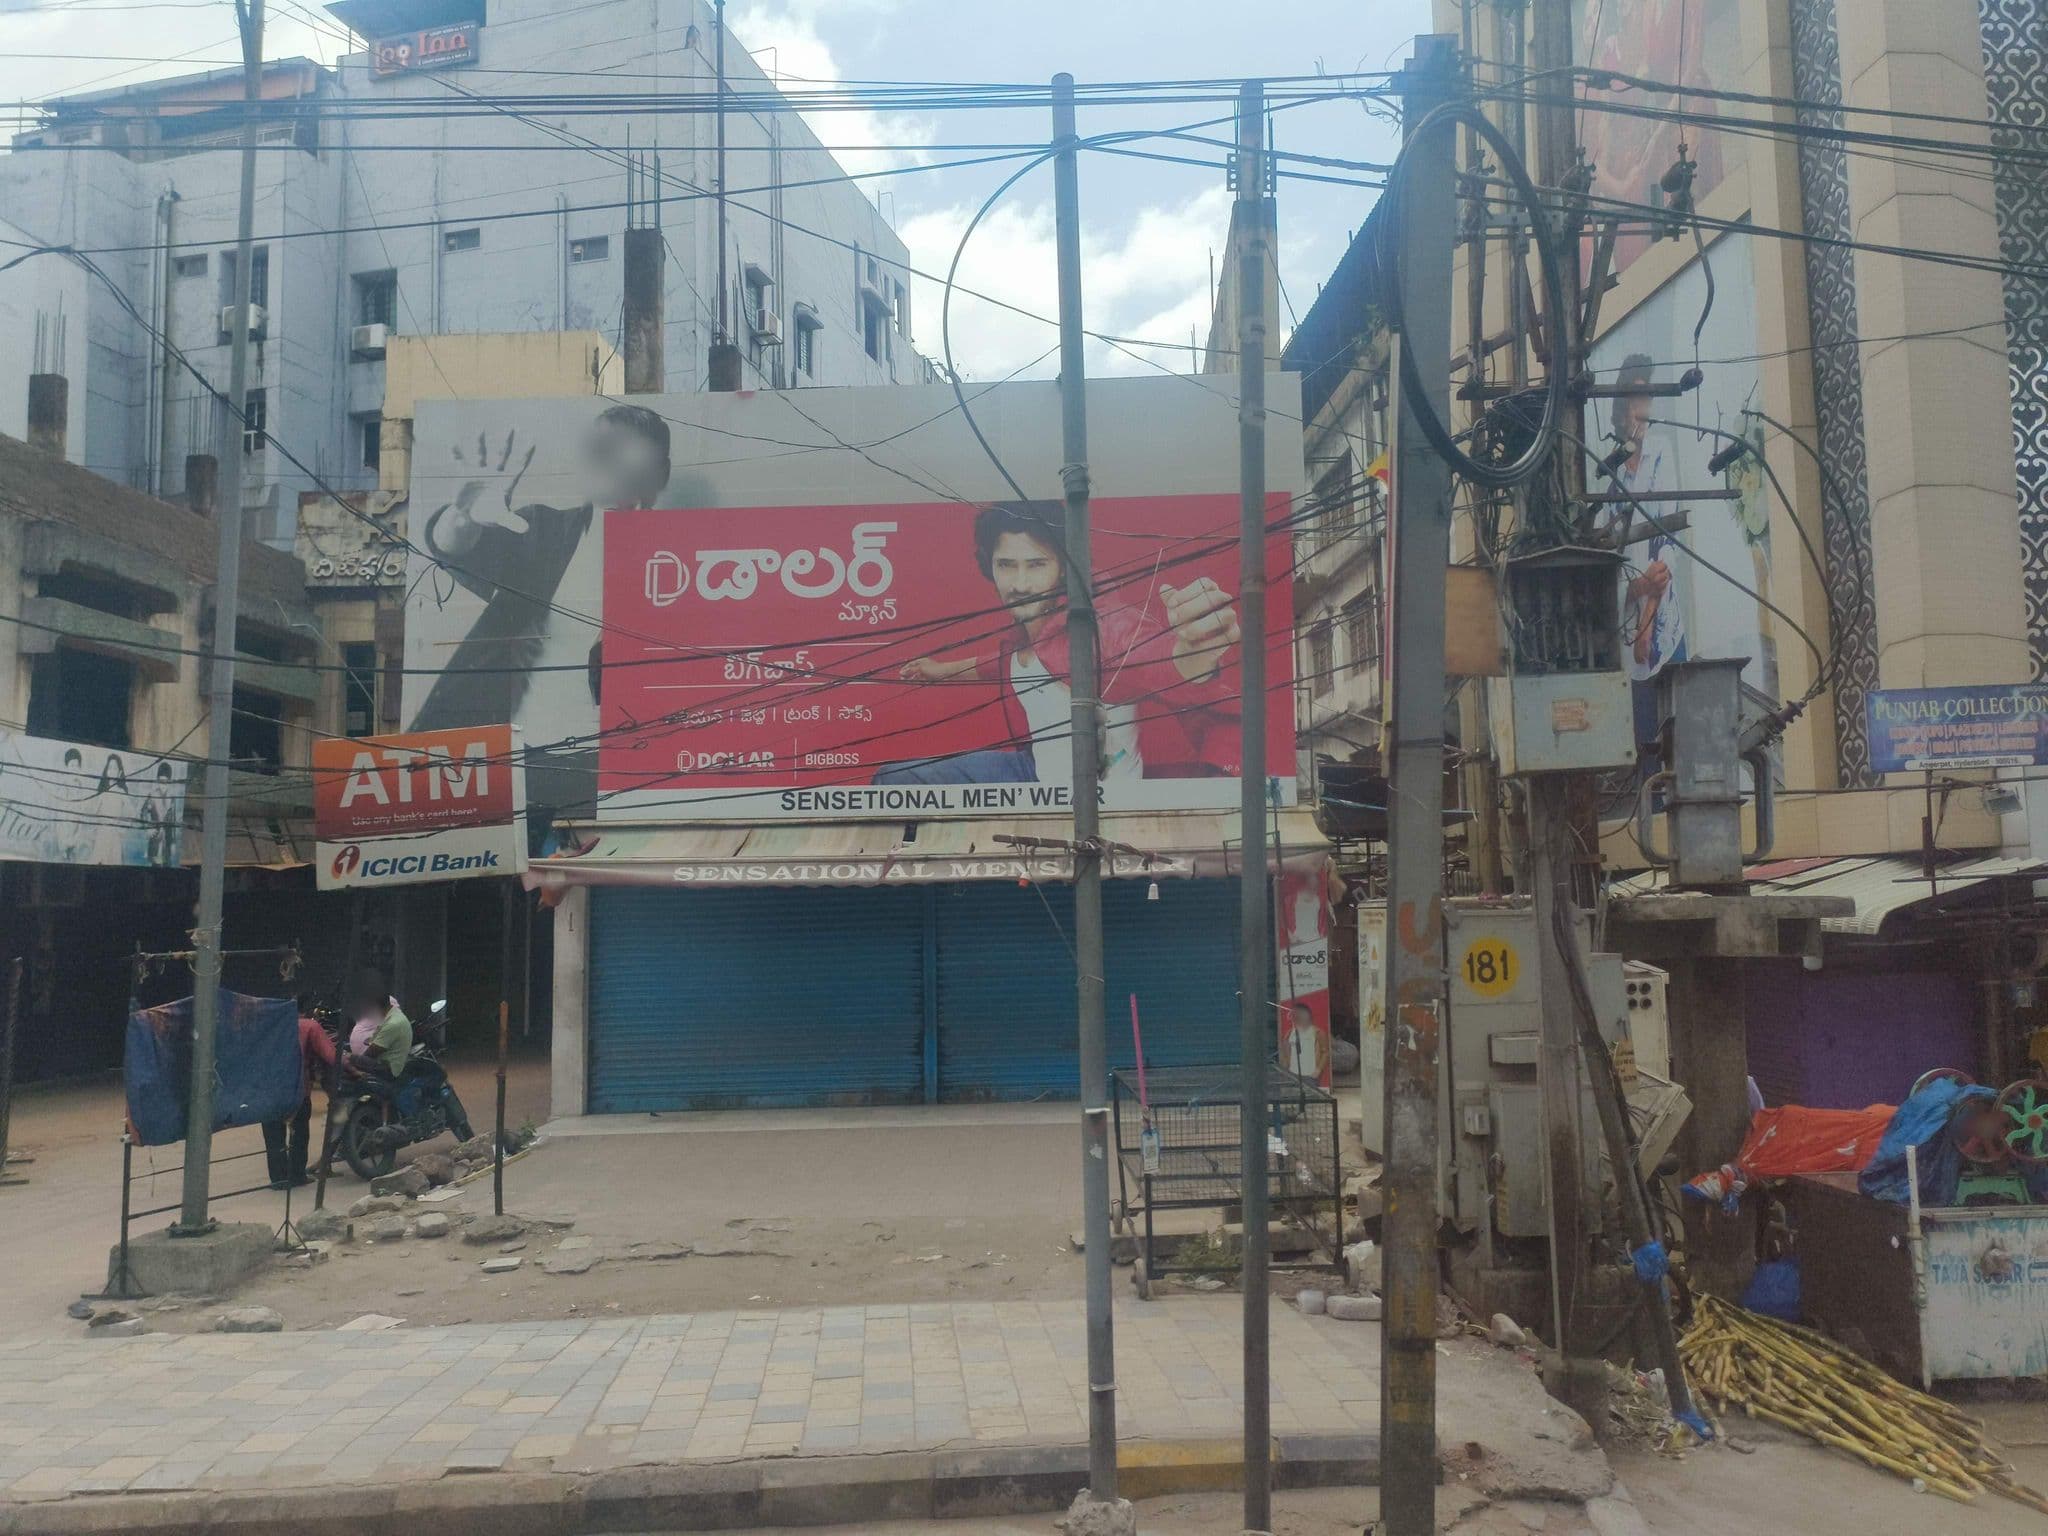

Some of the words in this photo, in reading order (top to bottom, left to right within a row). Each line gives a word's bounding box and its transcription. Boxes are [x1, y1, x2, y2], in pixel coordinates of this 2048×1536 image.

[695, 521, 898, 601] డాలర్
[838, 598, 896, 625] మ్యాన్
[1875, 699, 1940, 721] PUNJAB
[698, 752, 775, 769] DOLLAR
[805, 753, 860, 766] BIGBOSS
[340, 742, 488, 808] ATM
[781, 790, 954, 811] SENSETIONAL
[1029, 786, 1105, 806] WER
[361, 855, 427, 878] ICICI
[431, 850, 499, 872] Bank
[673, 863, 935, 881] SENSATIONAL
[1466, 948, 1509, 984] 181
